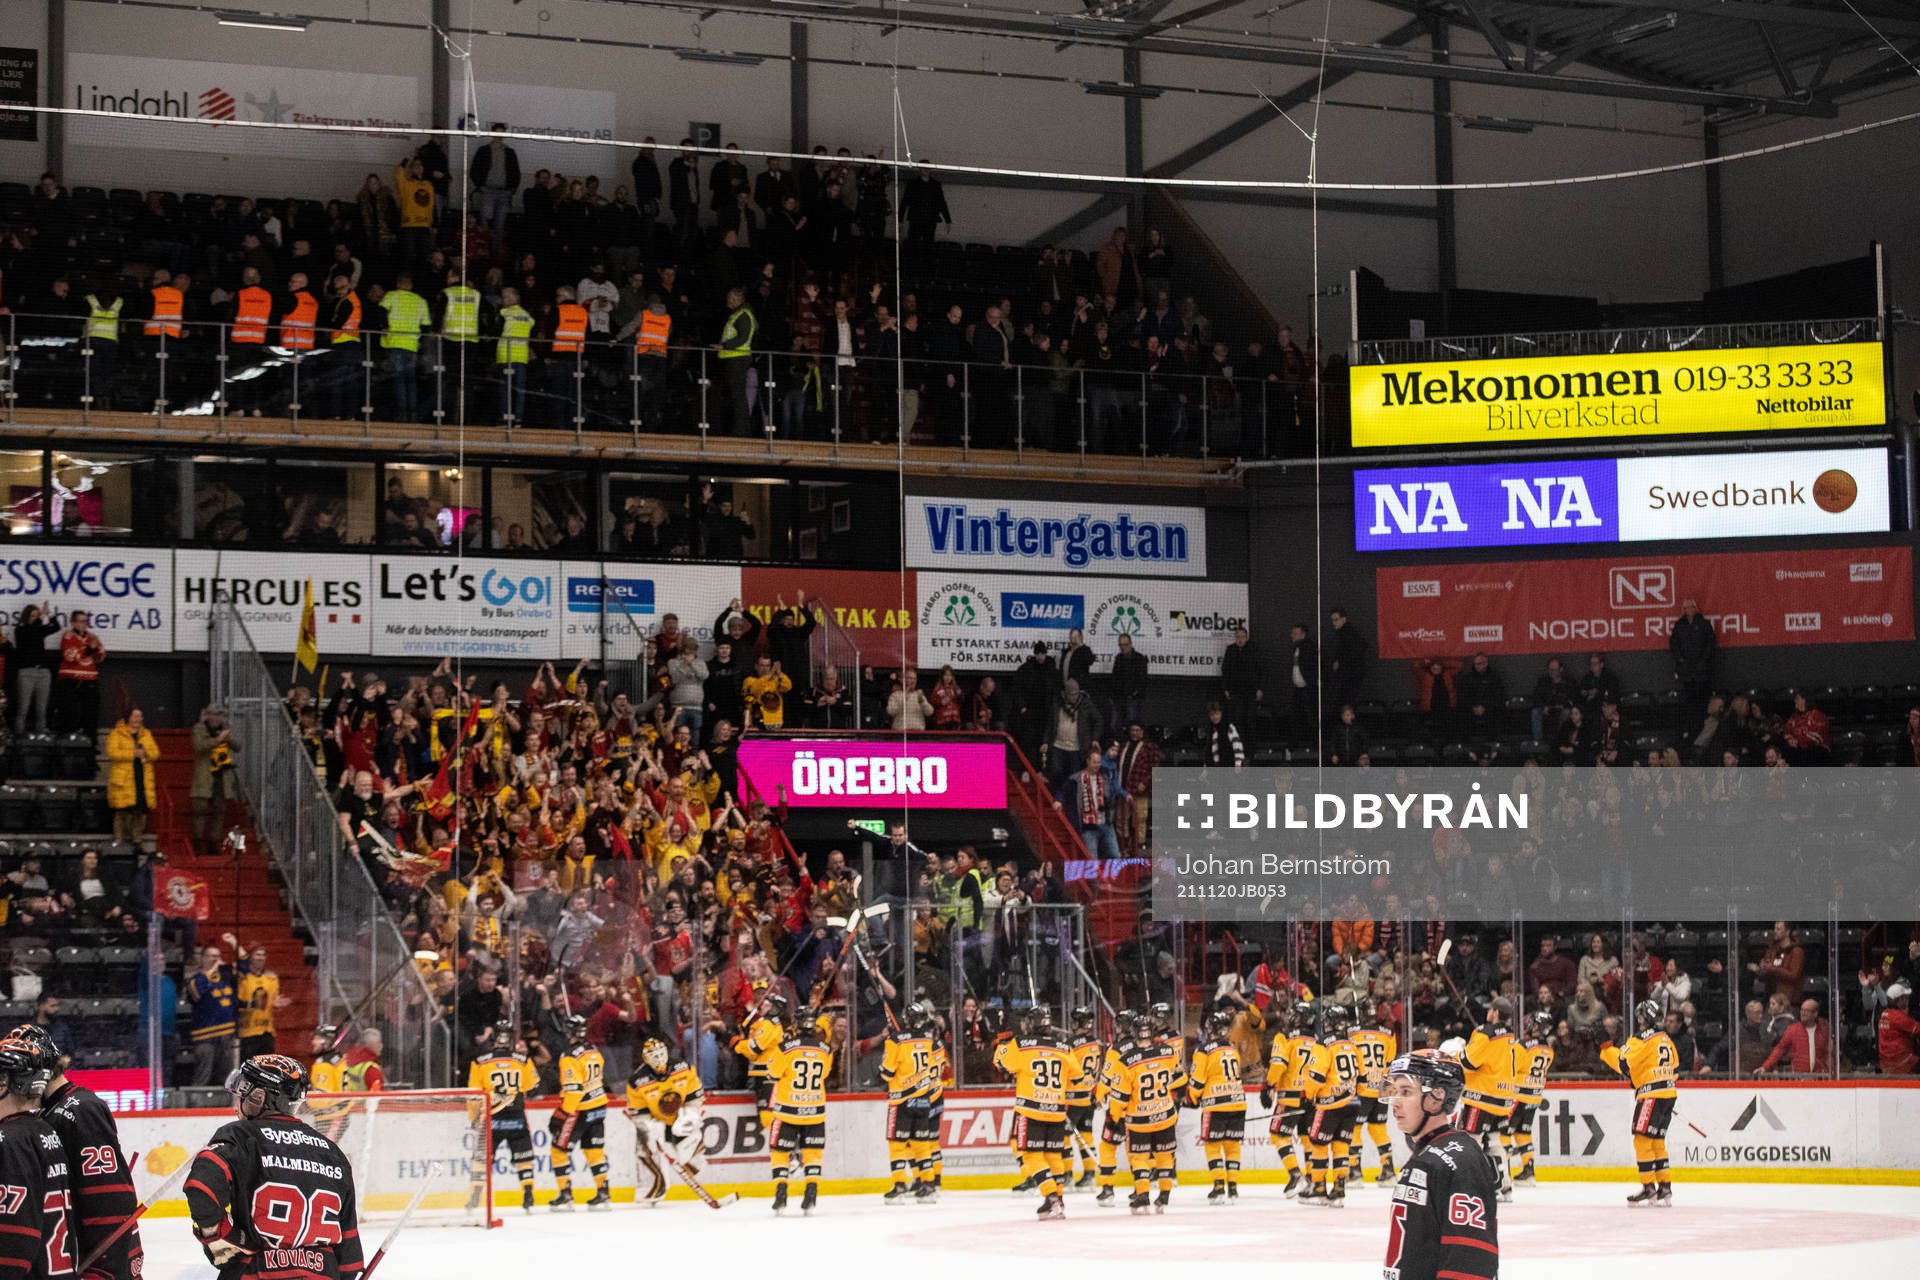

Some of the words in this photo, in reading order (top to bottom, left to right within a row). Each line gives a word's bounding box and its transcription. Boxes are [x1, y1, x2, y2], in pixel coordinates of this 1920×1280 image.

[77, 84, 189, 118] Lindahl
[1382, 368, 1661, 407] Mekonomen
[1674, 364, 1771, 392] 019-33
[1777, 362, 1812, 388] 33
[1818, 359, 1853, 386] 33
[1487, 399, 1660, 431] Bilverkstad
[1756, 396, 1854, 414] Nettobilar
[1368, 481, 1468, 535] NA
[1501, 476, 1602, 530] NA
[1649, 480, 1806, 510] Swedbank
[924, 503, 1189, 568] Vintergatan
[1616, 572, 1667, 604] NR
[127, 608, 161, 630] AB
[496, 608, 514, 618] Bus
[834, 607, 877, 629] TAK
[882, 609, 912, 630] AB
[1184, 611, 1247, 632] weber
[1529, 617, 1634, 641] NORDIC
[1645, 613, 1761, 637] RETAL
[408, 625, 422, 636] du
[931, 638, 953, 648] ETT
[956, 639, 1000, 650] STARKT
[1004, 640, 1074, 651] SAMABET
[950, 650, 973, 663] FÖR
[977, 653, 1022, 664] STARKA
[1189, 656, 1213, 666] MED
[792, 751, 947, 795] ÖREBRO
[491, 1071, 519, 1096] 24
[793, 1060, 823, 1090] 32
[1032, 1060, 1062, 1090] 39
[1140, 1070, 1169, 1101] 23
[260, 1127, 329, 1149] ByggTema
[80, 1145, 118, 1176] 29
[261, 1155, 343, 1180] MALMBERGS
[1721, 1146, 1831, 1162] BYGGDESIGN
[252, 1181, 342, 1249] 96
[1449, 1192, 1487, 1230] 62
